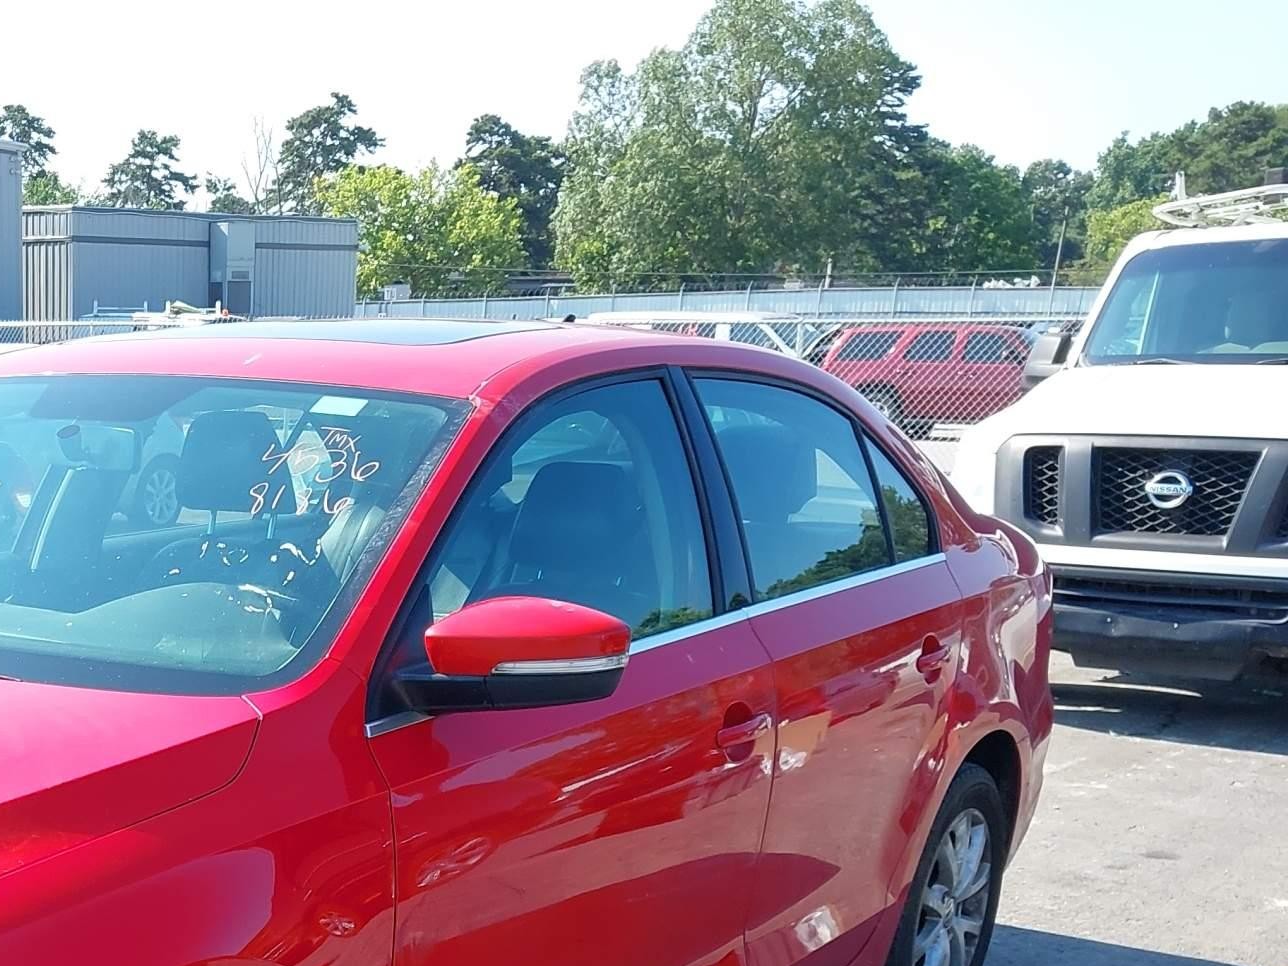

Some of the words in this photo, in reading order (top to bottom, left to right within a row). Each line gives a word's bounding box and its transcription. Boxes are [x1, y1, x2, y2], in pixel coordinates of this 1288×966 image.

[261, 442, 381, 482] 4536
[249, 482, 356, 517] 8186
[1149, 486, 1188, 494] NISSAN
